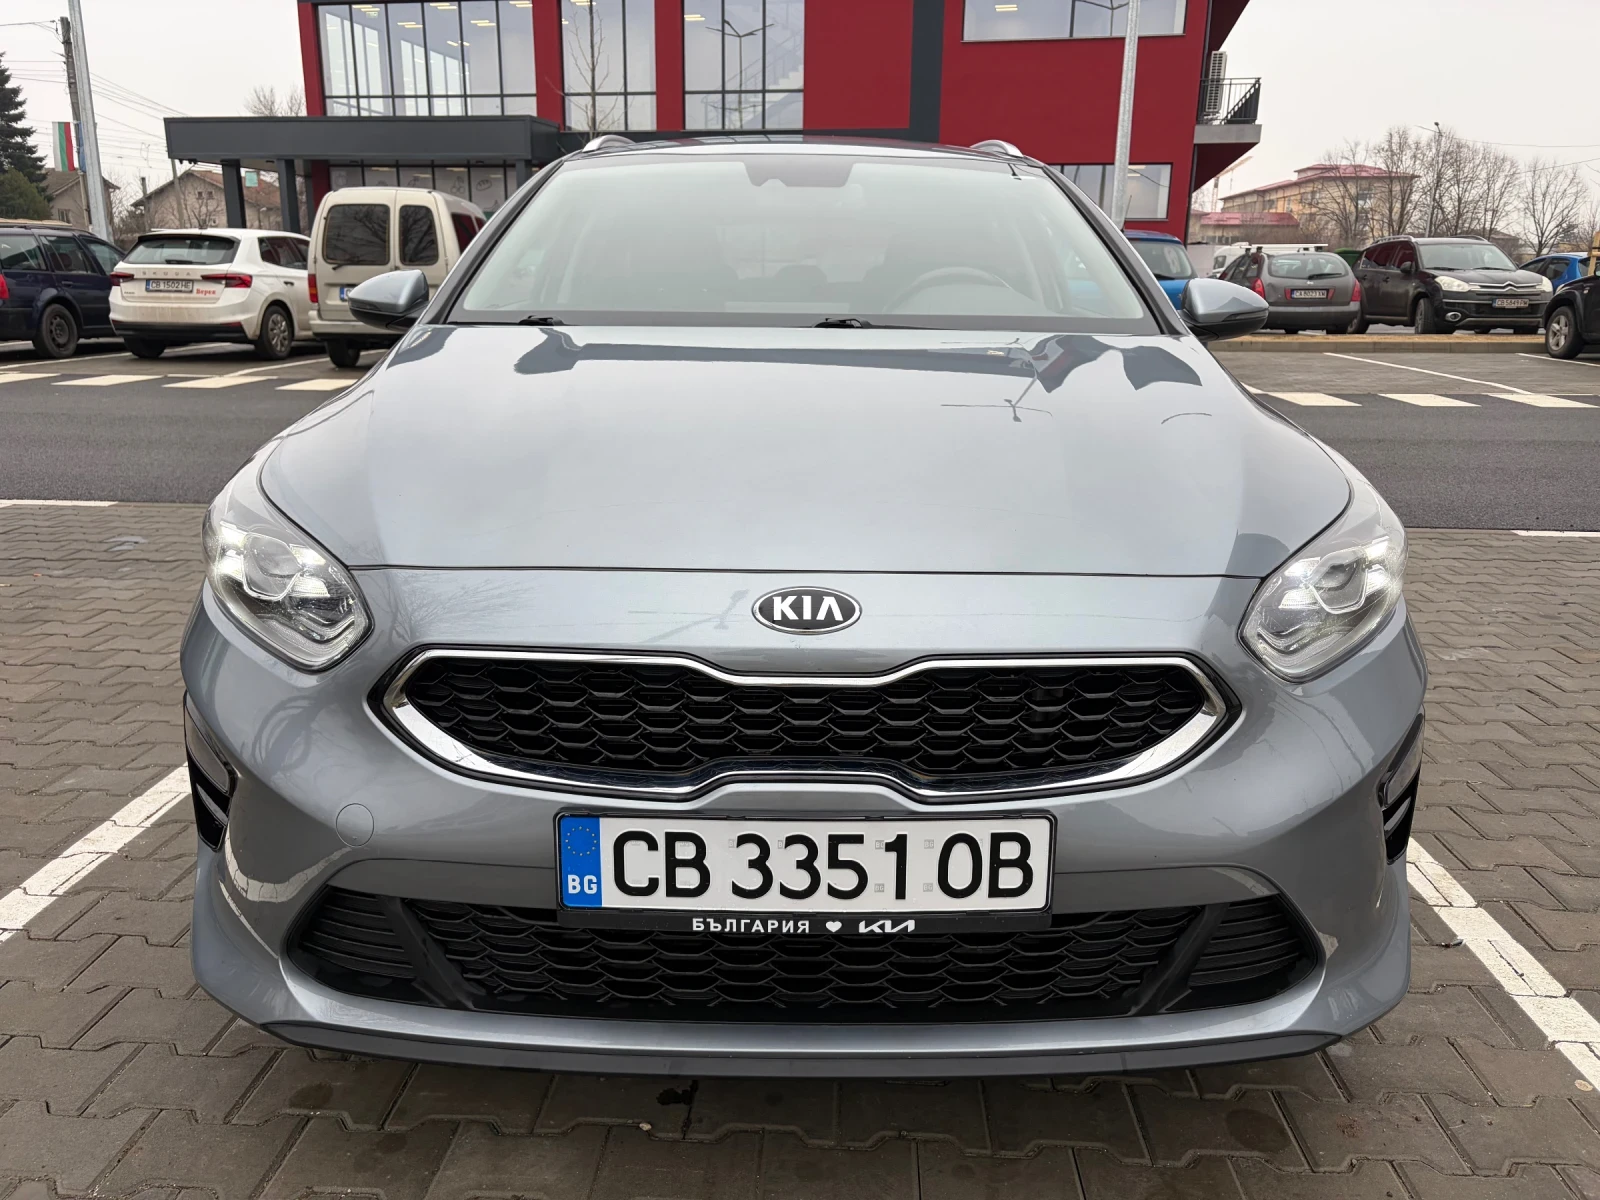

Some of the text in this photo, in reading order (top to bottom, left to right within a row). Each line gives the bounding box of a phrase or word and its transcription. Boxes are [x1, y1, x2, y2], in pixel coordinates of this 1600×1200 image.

[151, 281, 160, 289] CB
[163, 281, 181, 289] 1502
[773, 595, 844, 621] KIA
[613, 830, 711, 898] CB
[731, 832, 908, 900] 3351
[567, 874, 598, 895] BG
[692, 918, 810, 933] БЪЛГАРИЯ
